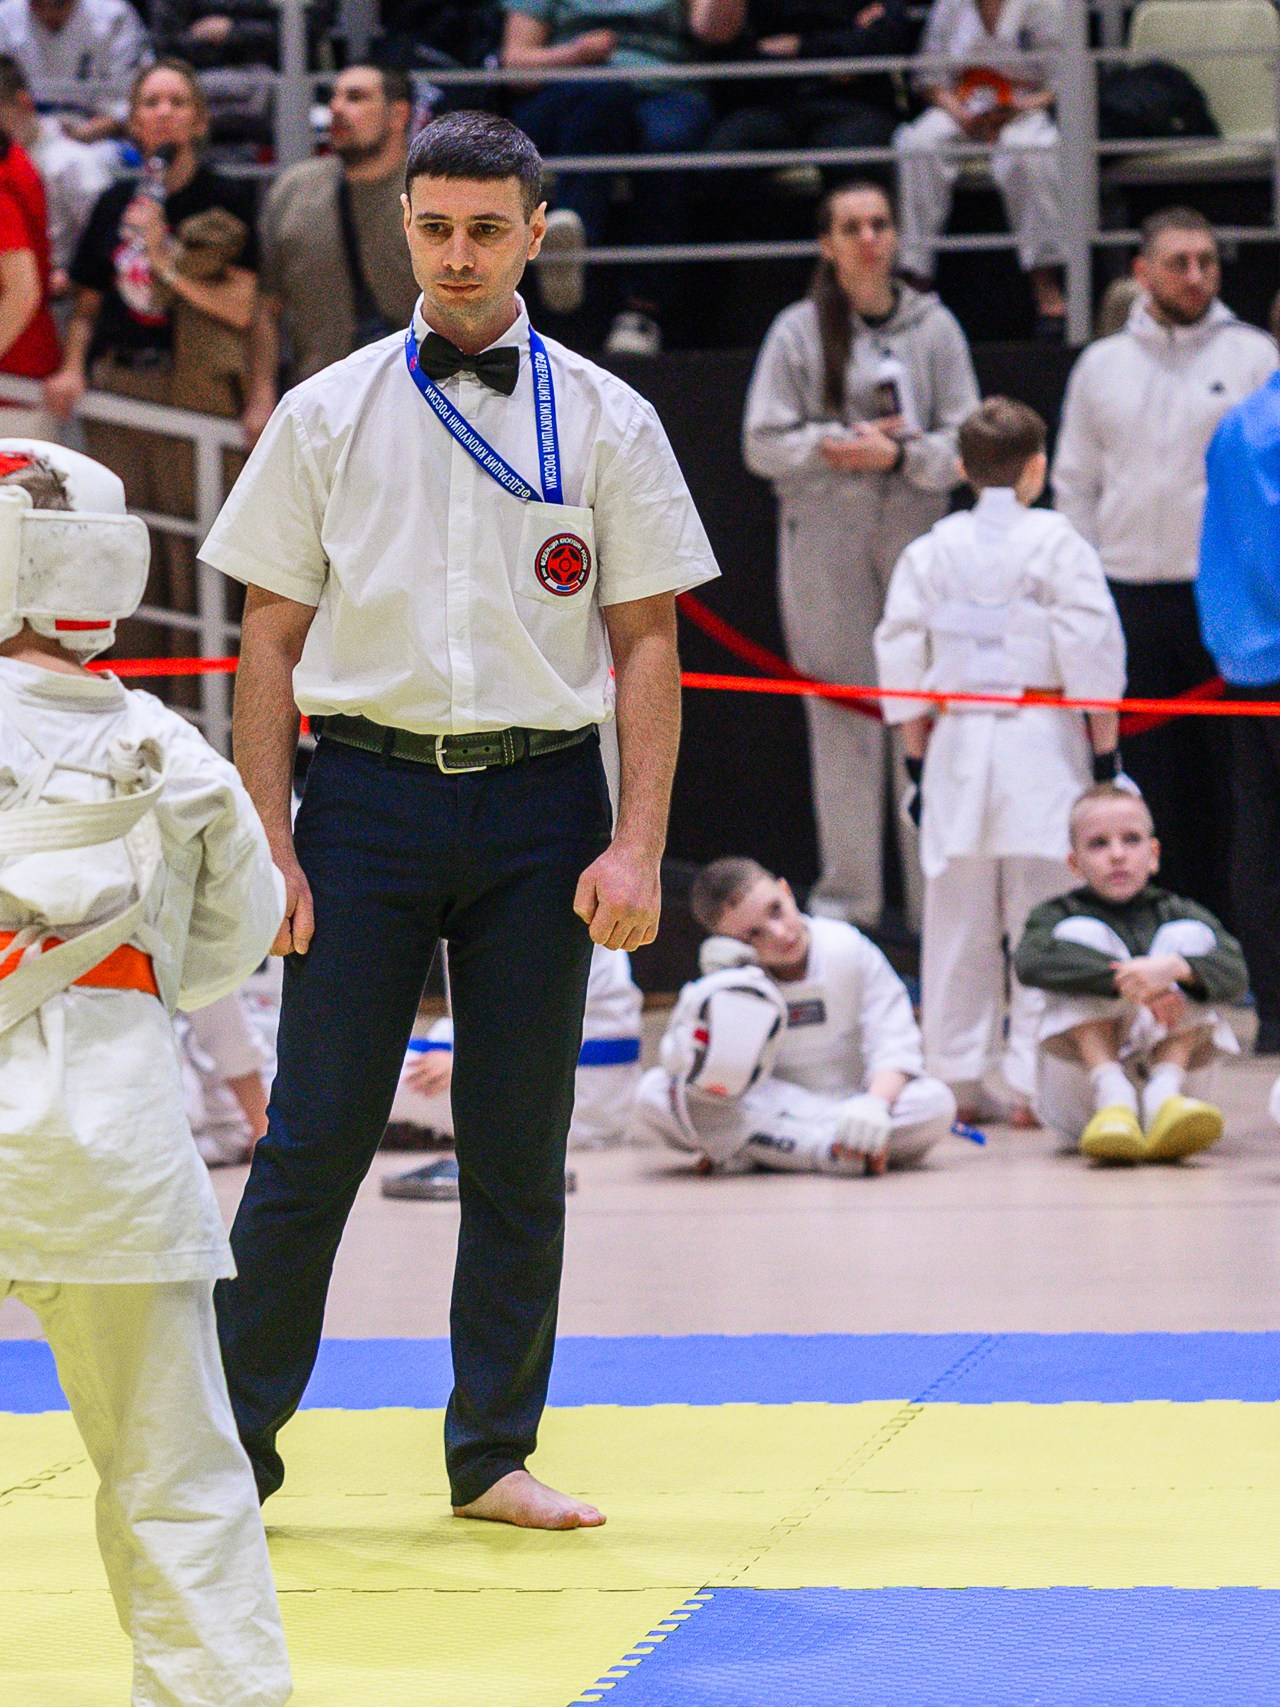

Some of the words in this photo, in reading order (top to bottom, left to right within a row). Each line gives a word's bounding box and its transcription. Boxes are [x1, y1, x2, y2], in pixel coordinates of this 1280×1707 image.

[534, 351, 549, 401] ФЕДЕРАЦИЯ
[424, 384, 452, 420] РОССИИ
[446, 414, 487, 460] КИОКУШИН
[539, 402, 554, 454] КИОКУШИН
[483, 453, 531, 498] ФЕДЕРАЦИЯ
[543, 454, 557, 489] РОССИИ
